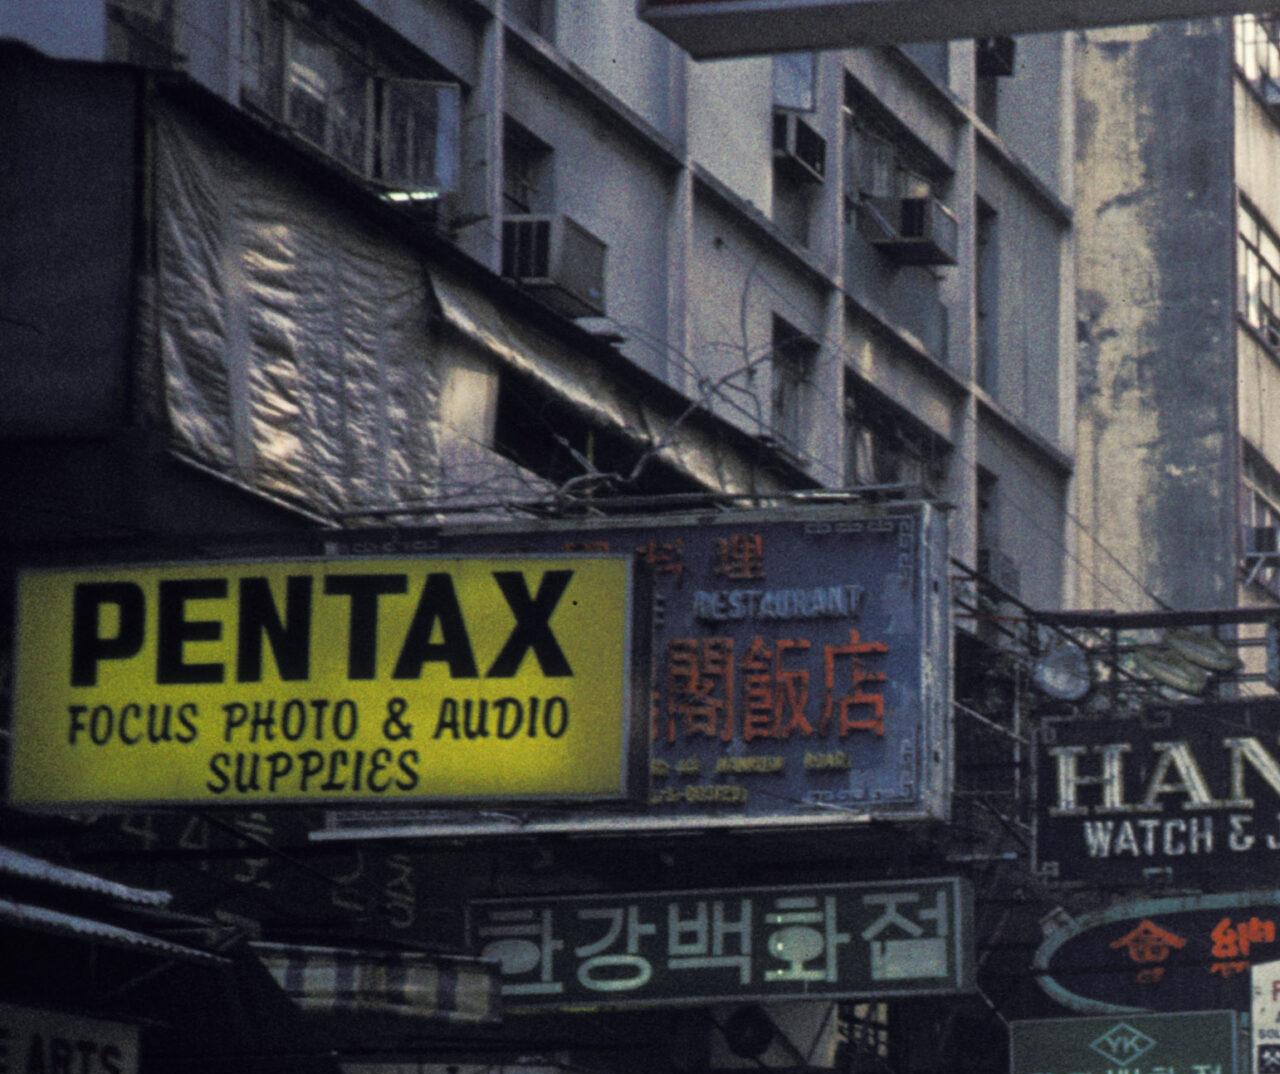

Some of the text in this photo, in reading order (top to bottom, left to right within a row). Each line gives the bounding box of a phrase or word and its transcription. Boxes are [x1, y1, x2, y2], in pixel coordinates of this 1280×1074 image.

[70, 569, 575, 687] PENTAX
[68, 696, 570, 745] FOCUS PHOTO & AUDIO
[208, 749, 421, 794] SUPPLIES
[1084, 816, 1212, 857] WATCH
[1228, 815, 1254, 850] &
